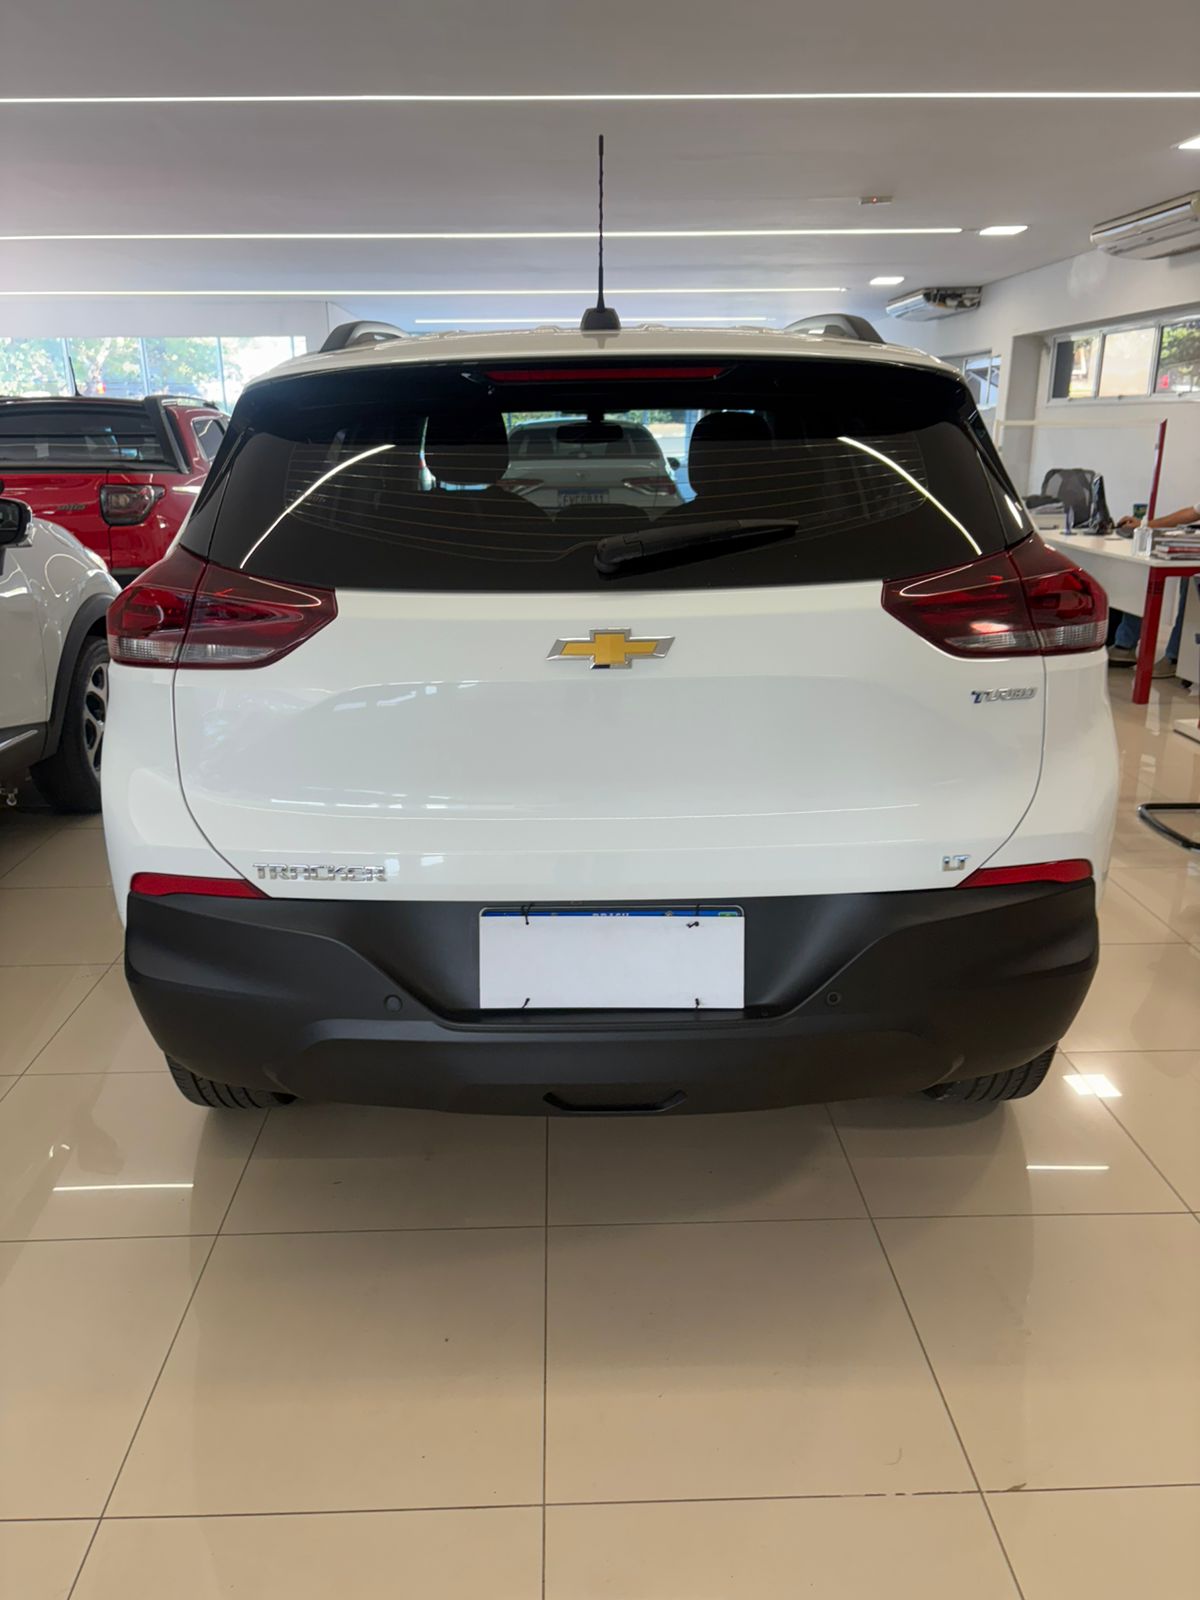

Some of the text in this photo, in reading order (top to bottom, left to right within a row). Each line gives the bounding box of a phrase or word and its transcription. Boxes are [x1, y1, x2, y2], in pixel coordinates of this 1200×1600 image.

[971, 687, 1037, 704] TURBO
[943, 854, 970, 871] LT
[253, 863, 387, 882] TRACKER
